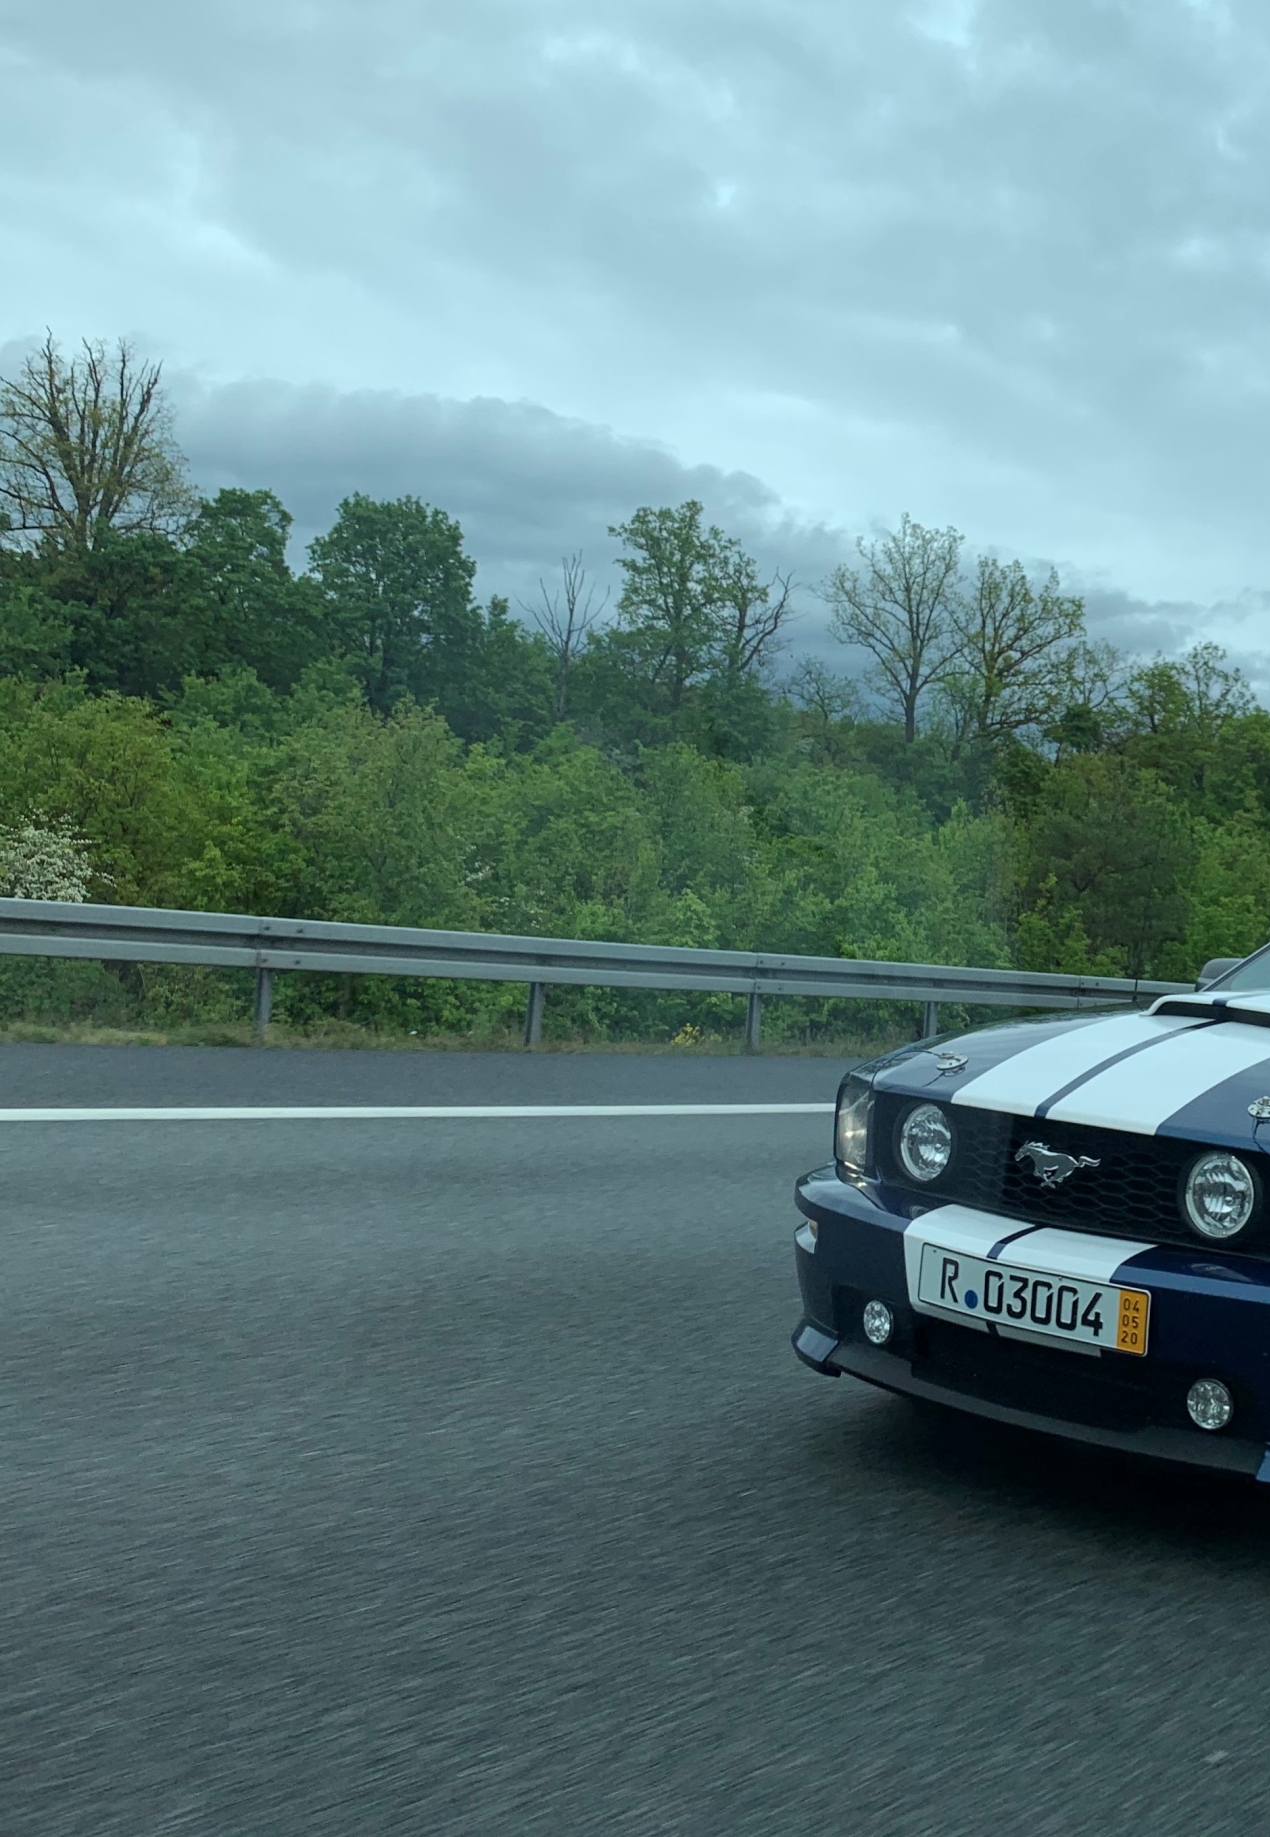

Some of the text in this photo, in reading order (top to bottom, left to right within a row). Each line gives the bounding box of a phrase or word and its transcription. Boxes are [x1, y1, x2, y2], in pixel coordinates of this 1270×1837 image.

[940, 1257, 1103, 1337] R 03004
[1123, 1297, 1140, 1313] 04
[1122, 1315, 1139, 1329] 05
[1121, 1329, 1138, 1345] 20
